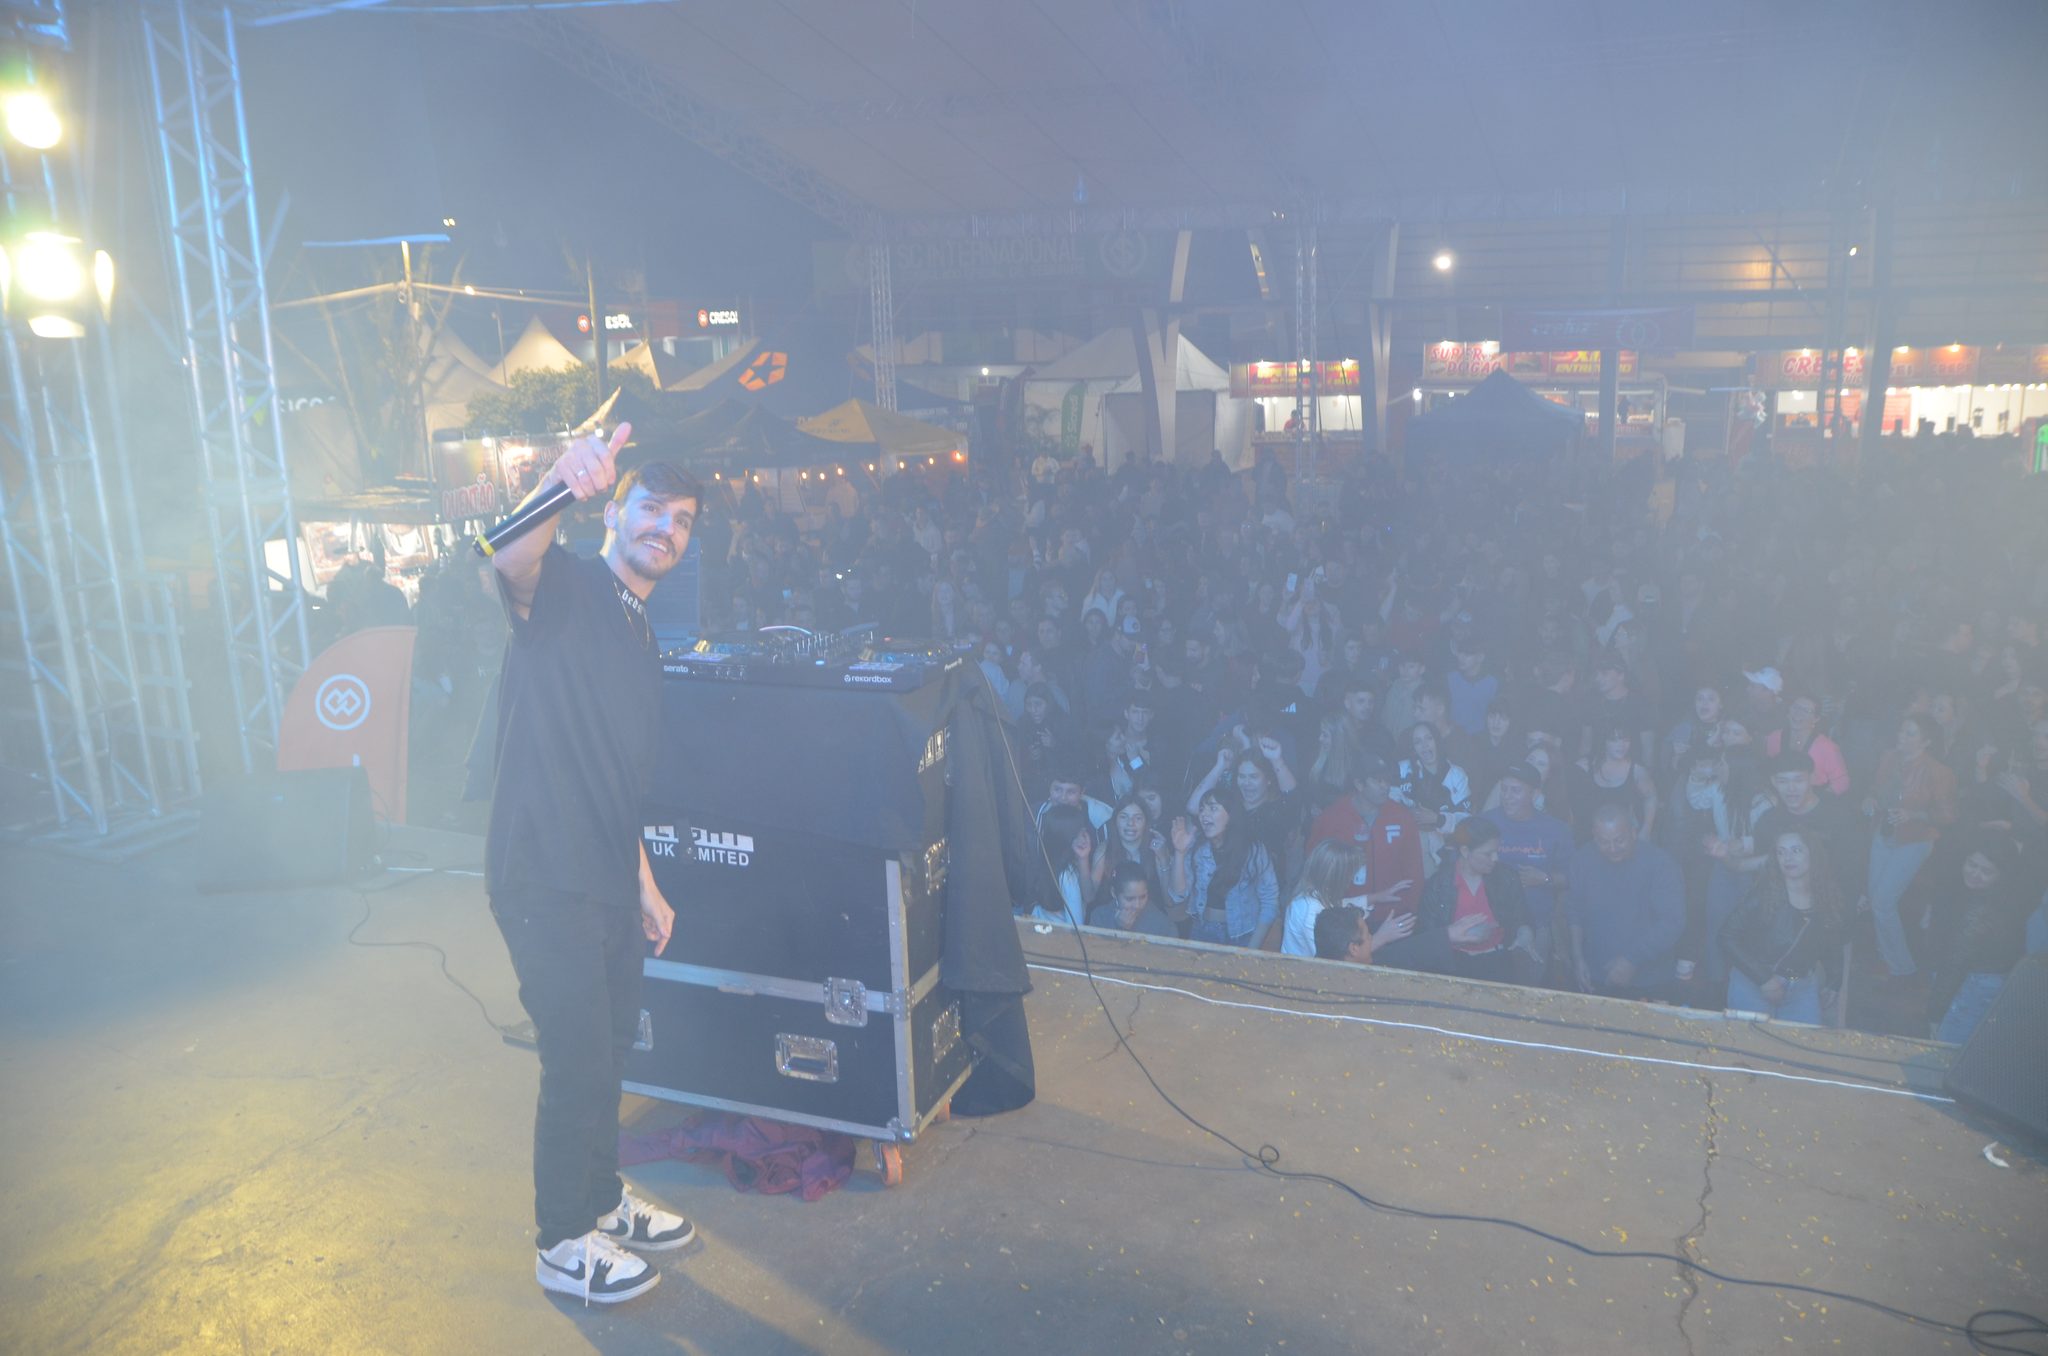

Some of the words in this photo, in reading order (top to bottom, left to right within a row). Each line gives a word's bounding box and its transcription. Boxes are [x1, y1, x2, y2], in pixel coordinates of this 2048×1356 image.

[663, 664, 689, 673] serato
[851, 674, 893, 684] rekordbox
[652, 841, 676, 857] UK
[692, 847, 750, 867] MITED
